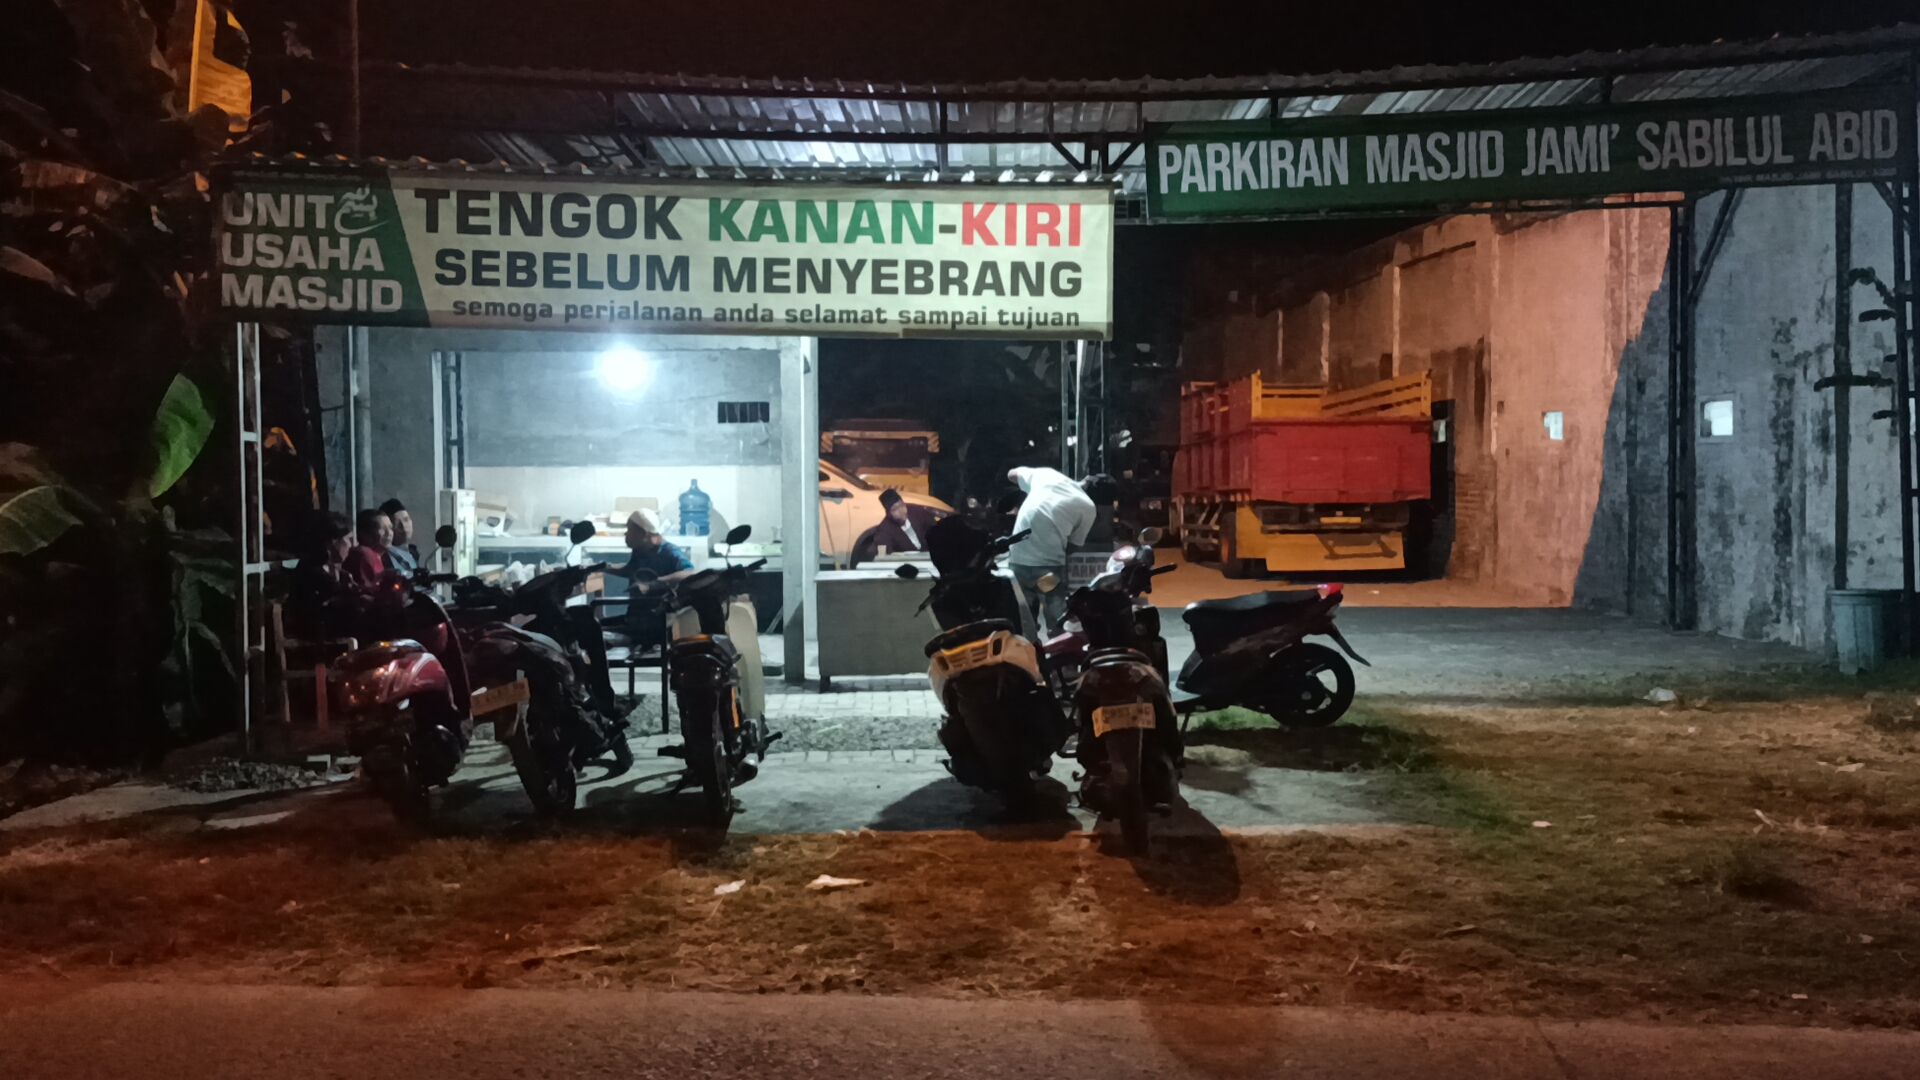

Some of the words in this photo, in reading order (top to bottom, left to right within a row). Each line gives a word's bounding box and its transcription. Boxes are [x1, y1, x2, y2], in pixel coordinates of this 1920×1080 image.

[1158, 137, 1349, 194] PARKIRAN
[1365, 130, 1505, 184] MASJID
[1636, 115, 1794, 170] SABILUL
[1809, 109, 1898, 161] ABID
[223, 192, 334, 229] UNIT
[414, 187, 682, 241] TENGOK
[708, 197, 1081, 247] KANAN-KIRI
[221, 233, 384, 272] USAHA
[434, 248, 690, 292] SEBELUM
[713, 256, 1082, 297] MENYEBRANG
[221, 273, 403, 313] MASJID
[453, 300, 553, 322] semoga
[564, 301, 702, 323] perjalanan
[713, 303, 774, 324] anda
[785, 304, 888, 325] selamat
[899, 306, 987, 330] sampai
[998, 308, 1080, 330] tujuan
